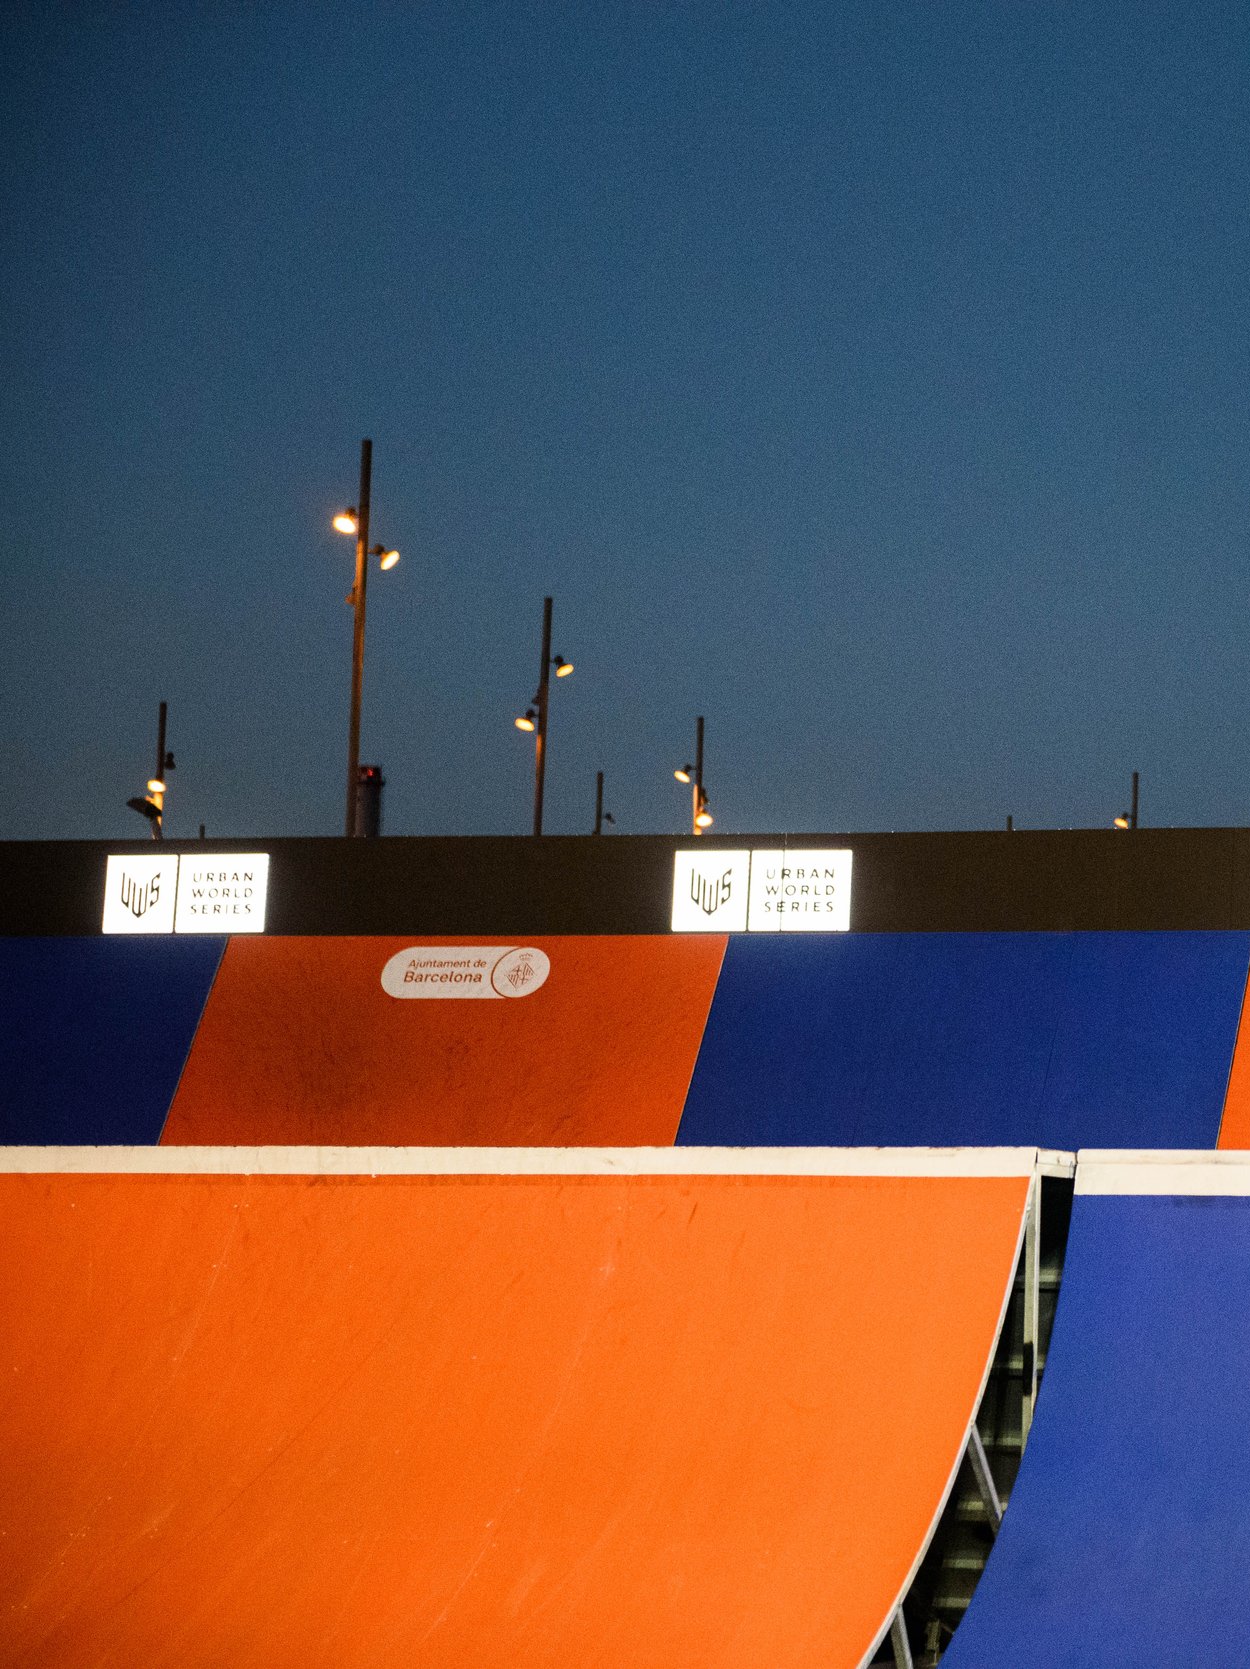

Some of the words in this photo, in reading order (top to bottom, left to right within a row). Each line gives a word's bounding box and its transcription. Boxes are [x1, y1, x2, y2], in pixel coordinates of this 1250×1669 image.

[193, 872, 254, 882] URBAN
[766, 868, 835, 879] URBAN
[192, 888, 253, 898] WORLD
[765, 885, 835, 896] WORLD
[190, 904, 252, 914] SERIES
[764, 901, 834, 912] SERIES
[408, 959, 471, 970] Ajuntament
[473, 959, 487, 968] de
[403, 970, 483, 983] Barcelona
